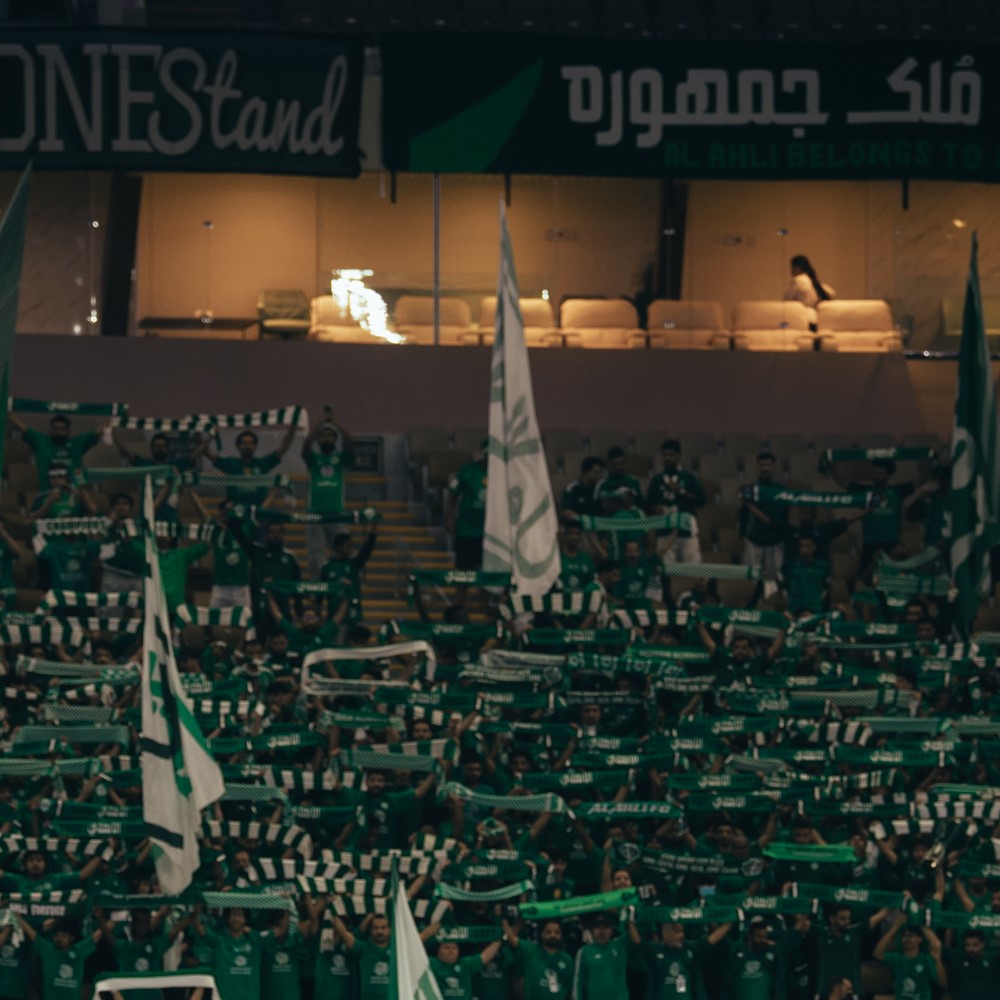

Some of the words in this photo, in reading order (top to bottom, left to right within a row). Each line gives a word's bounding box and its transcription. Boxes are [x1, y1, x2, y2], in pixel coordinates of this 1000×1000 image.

[664, 141, 700, 168] AL
[709, 142, 777, 168] AHLI
[791, 141, 931, 169] BELONGS
[936, 141, 982, 171] TO
